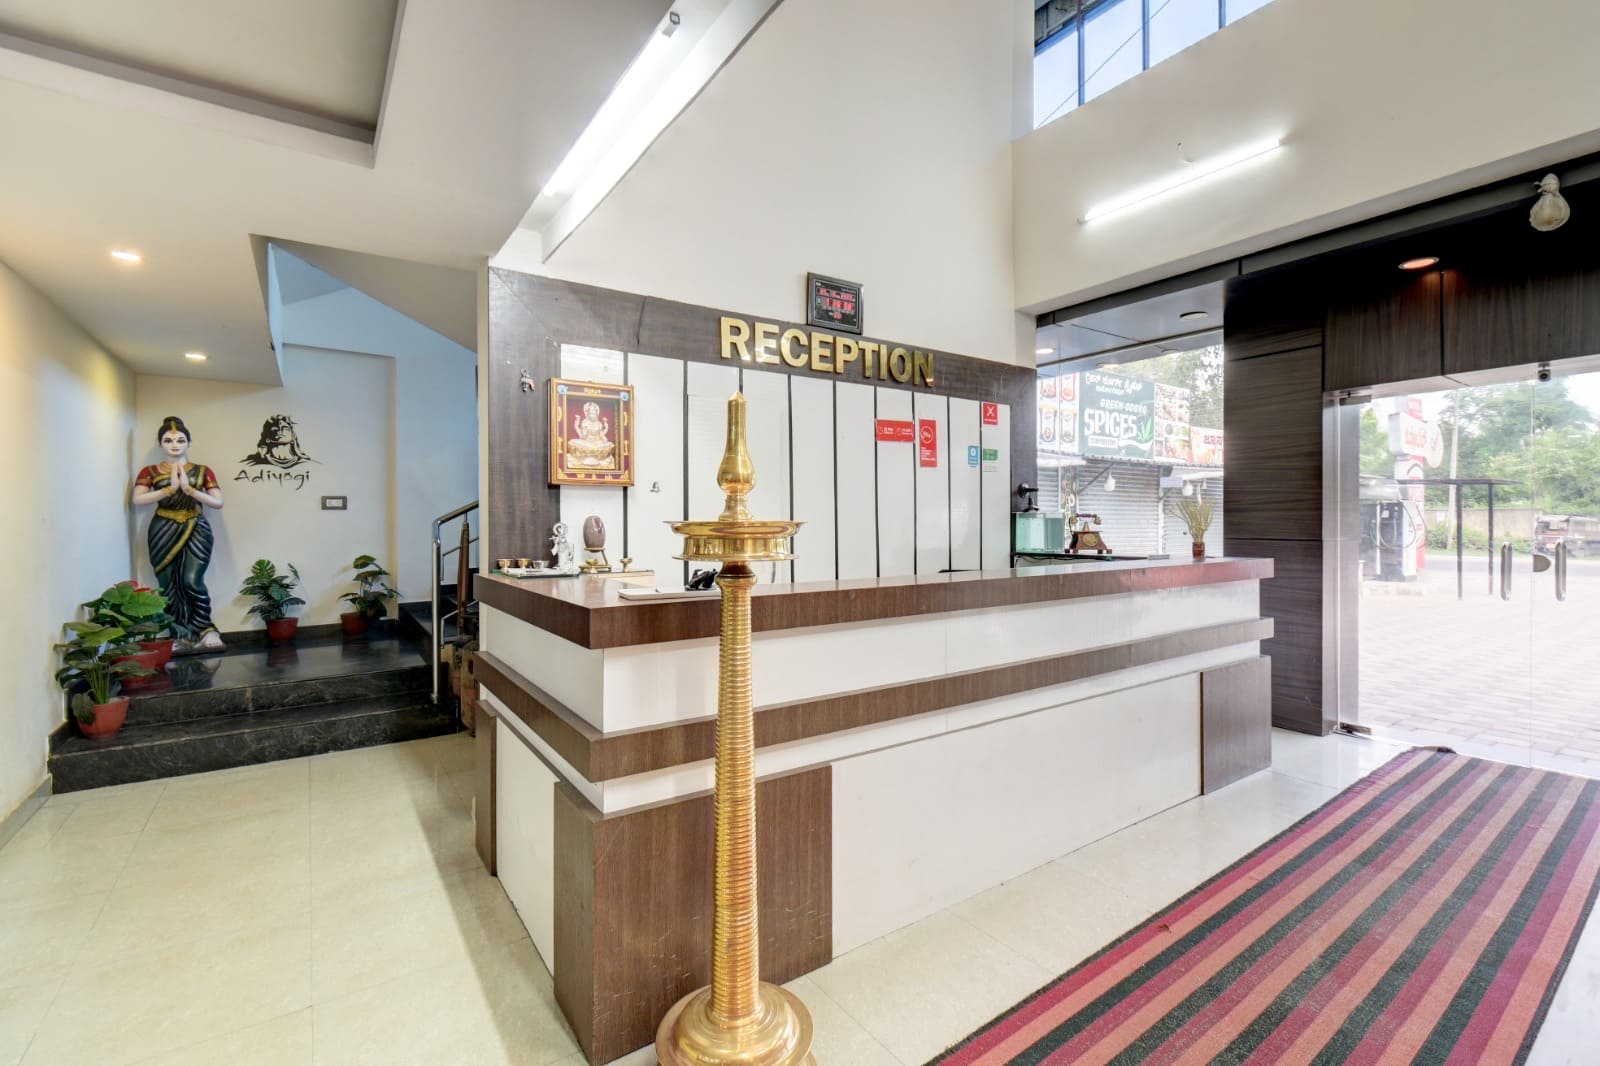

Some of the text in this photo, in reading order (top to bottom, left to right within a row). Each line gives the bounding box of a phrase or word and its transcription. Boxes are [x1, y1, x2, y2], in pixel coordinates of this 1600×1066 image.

[720, 316, 934, 386] RECEPTION
[1084, 408, 1137, 439] SPICES
[234, 469, 310, 491] Adiyogi
